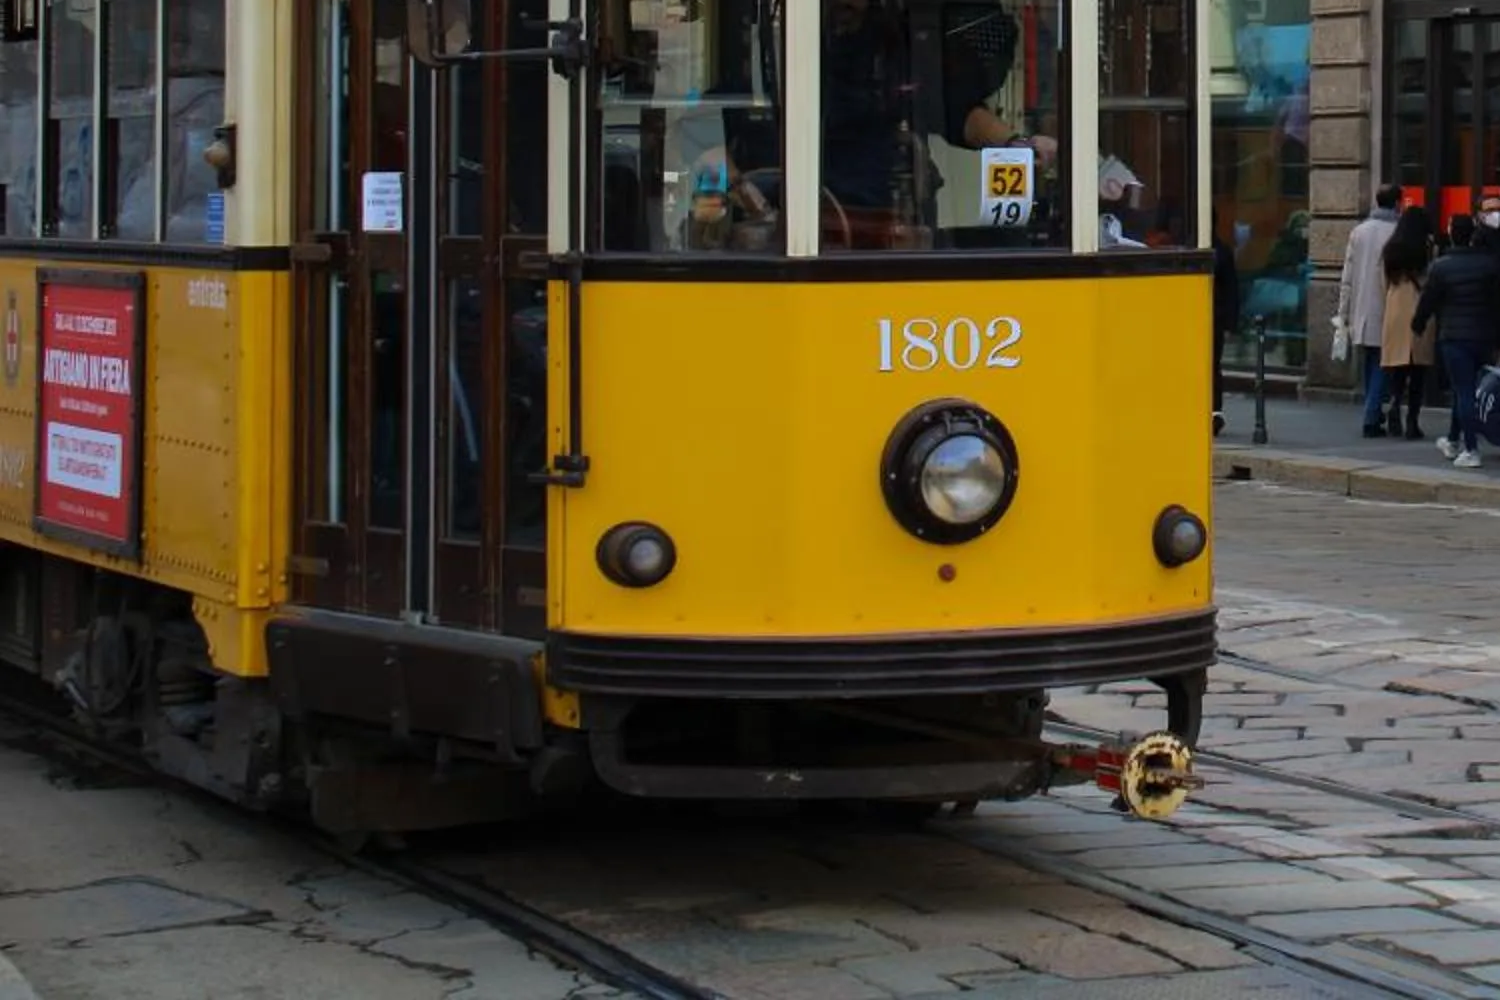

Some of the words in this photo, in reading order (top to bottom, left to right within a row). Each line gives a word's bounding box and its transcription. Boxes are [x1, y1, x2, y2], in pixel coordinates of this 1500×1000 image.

[992, 167, 1023, 196] 52
[991, 201, 1020, 227] 19
[879, 316, 1022, 371] 1802
